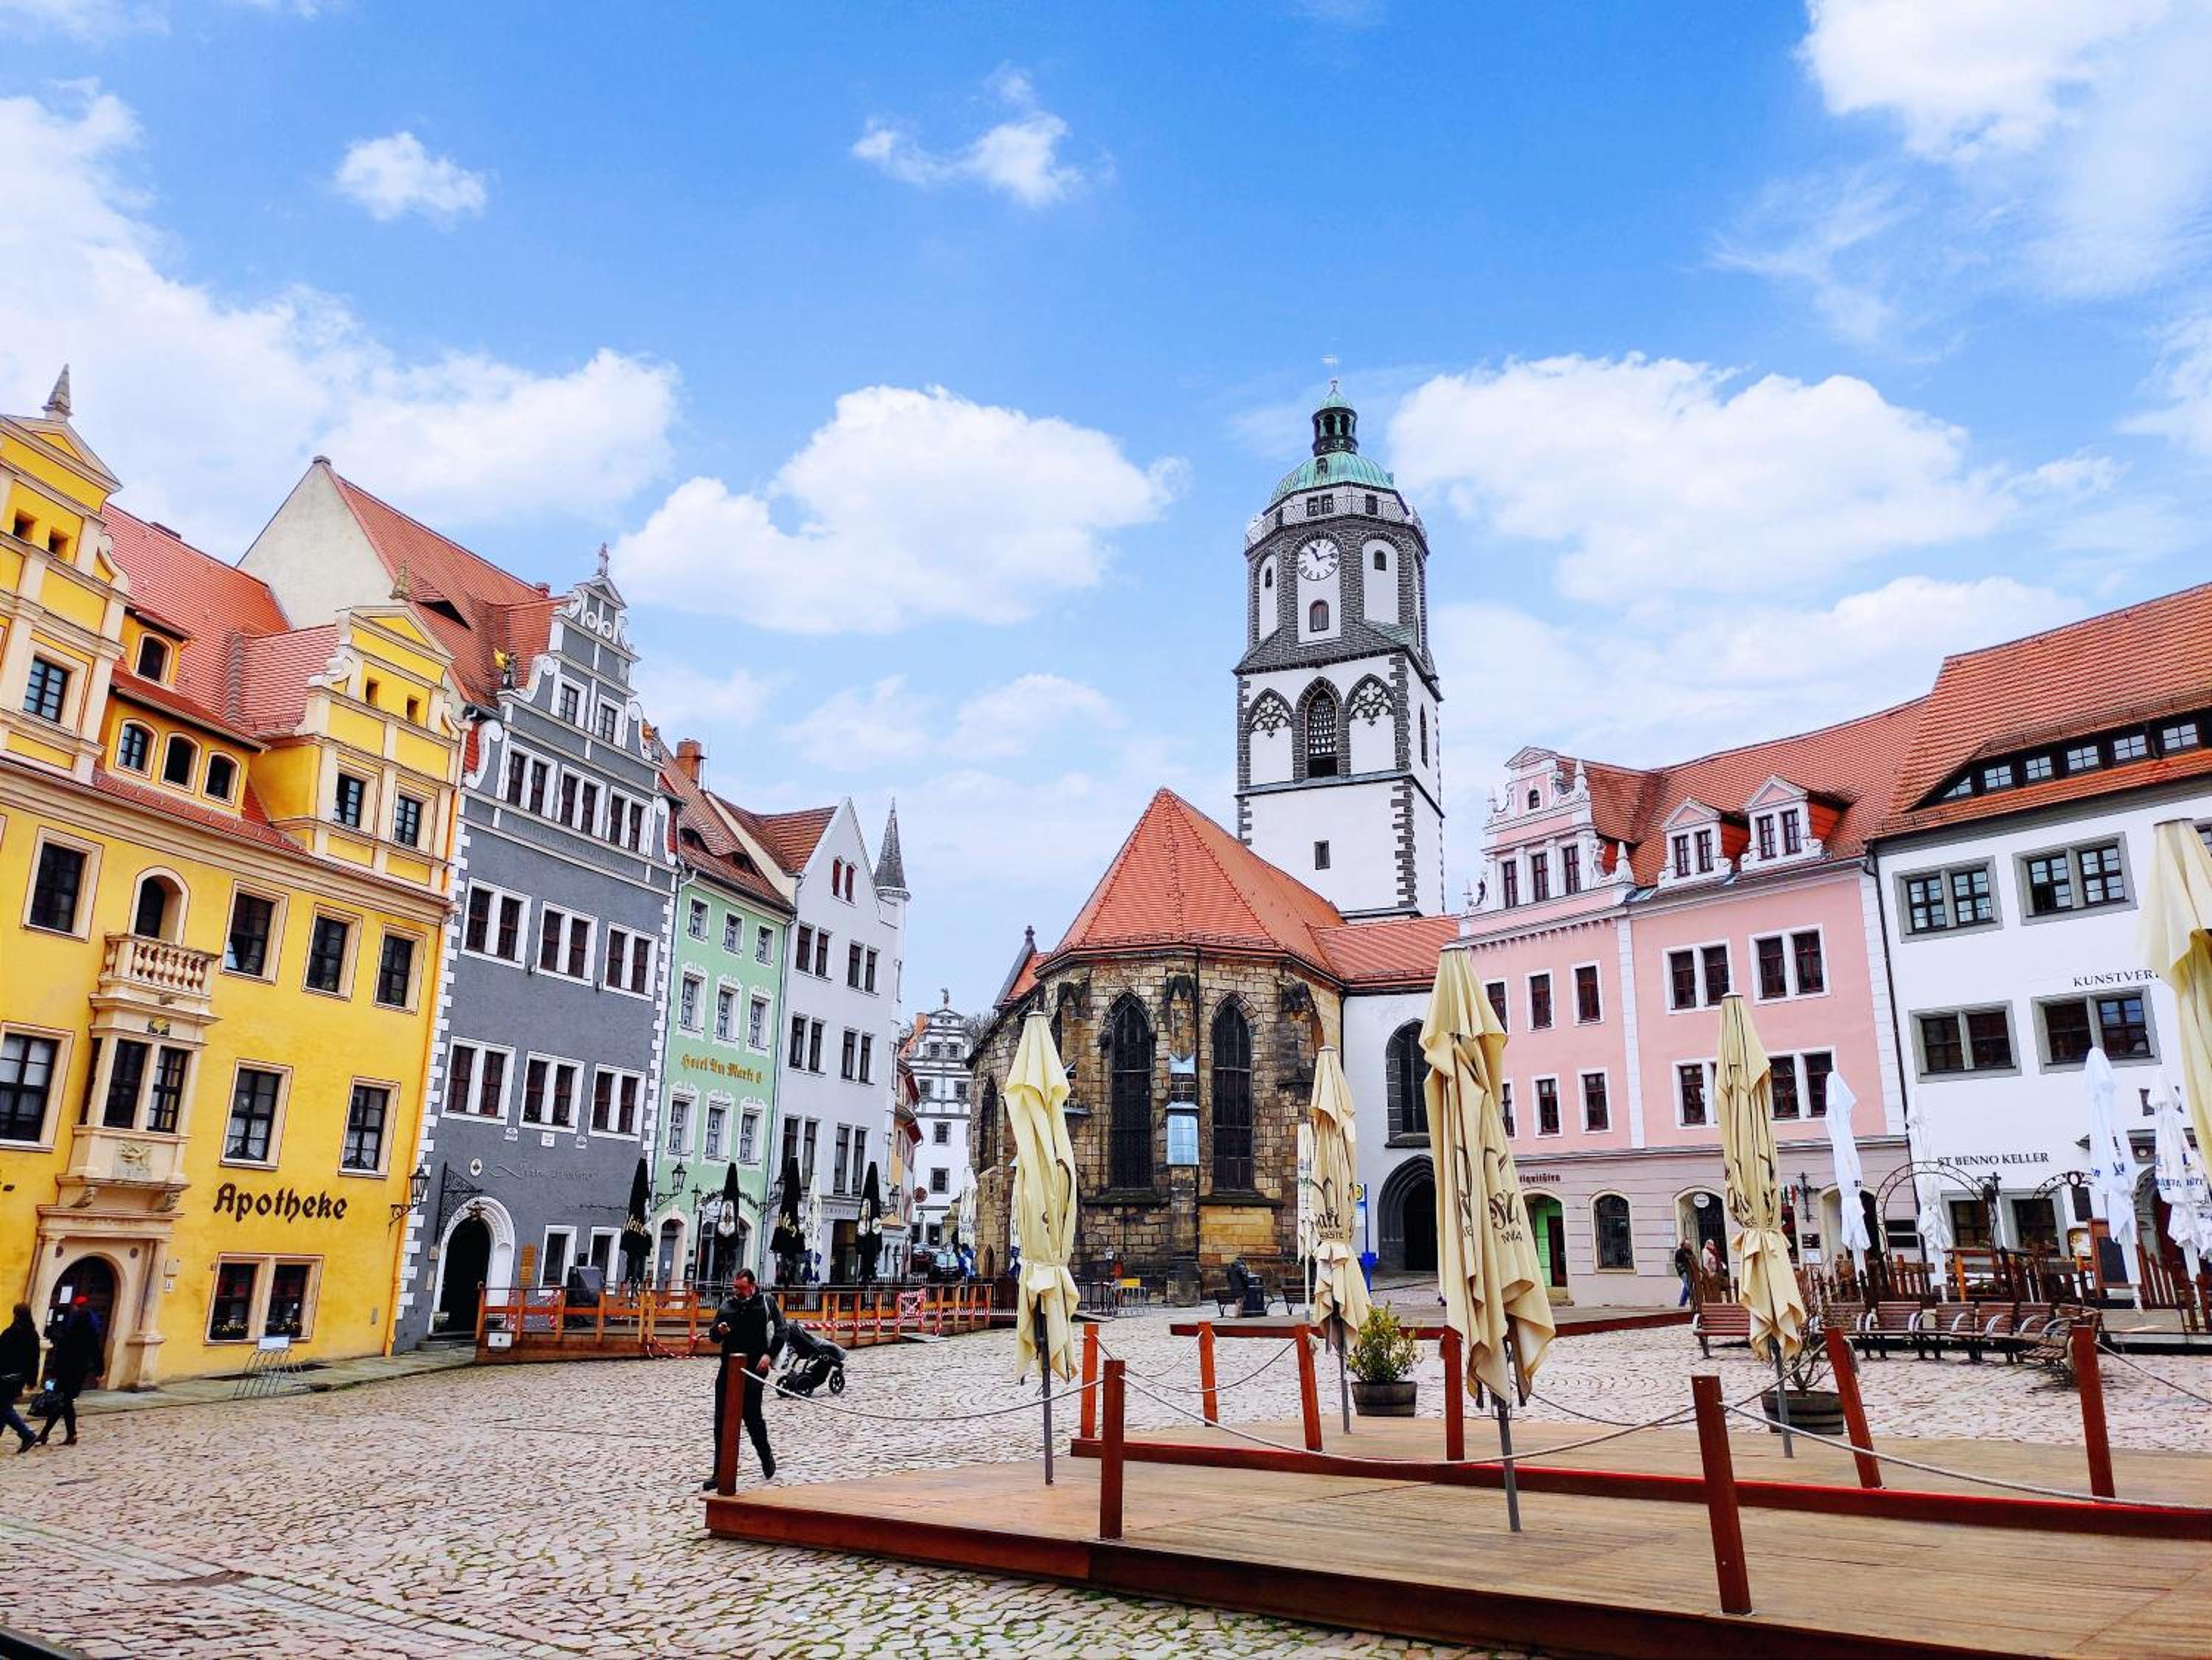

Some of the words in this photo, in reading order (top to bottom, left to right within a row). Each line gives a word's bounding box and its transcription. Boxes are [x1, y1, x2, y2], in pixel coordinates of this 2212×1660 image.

[2073, 969, 2159, 986] KUNSTVER
[1955, 1155, 1999, 1165] BENNO
[2002, 1152, 2049, 1164] KELLER
[1520, 1173, 1561, 1184] tiquitäten
[213, 1182, 347, 1224] Apotheke
